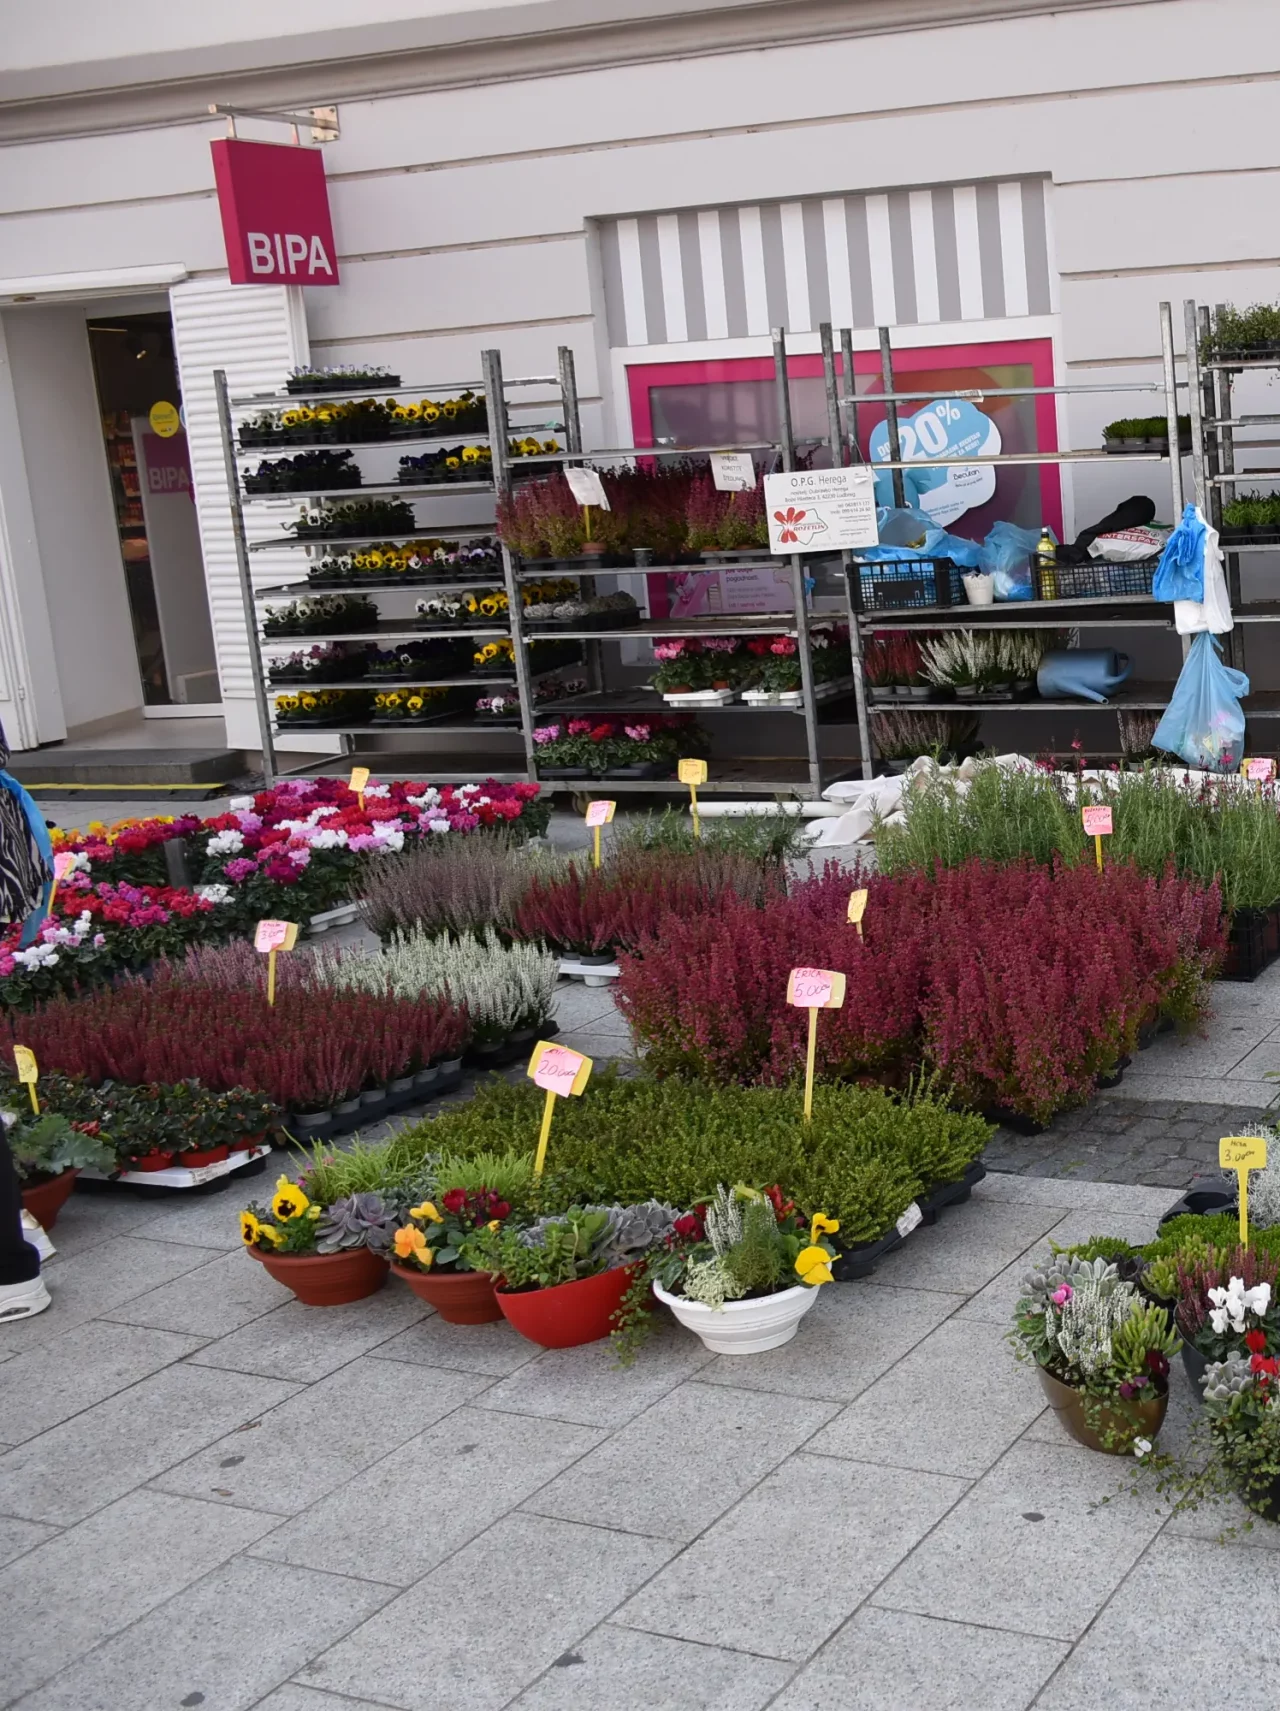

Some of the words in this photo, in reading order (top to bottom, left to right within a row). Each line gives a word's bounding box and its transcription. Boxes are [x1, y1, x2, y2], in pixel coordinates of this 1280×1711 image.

[247, 232, 333, 275] BIPA
[148, 467, 190, 490] BIPA
[818, 475, 847, 486] Herega
[1100, 532, 1160, 546] INTERSPAR
[795, 969, 821, 979] ERICA
